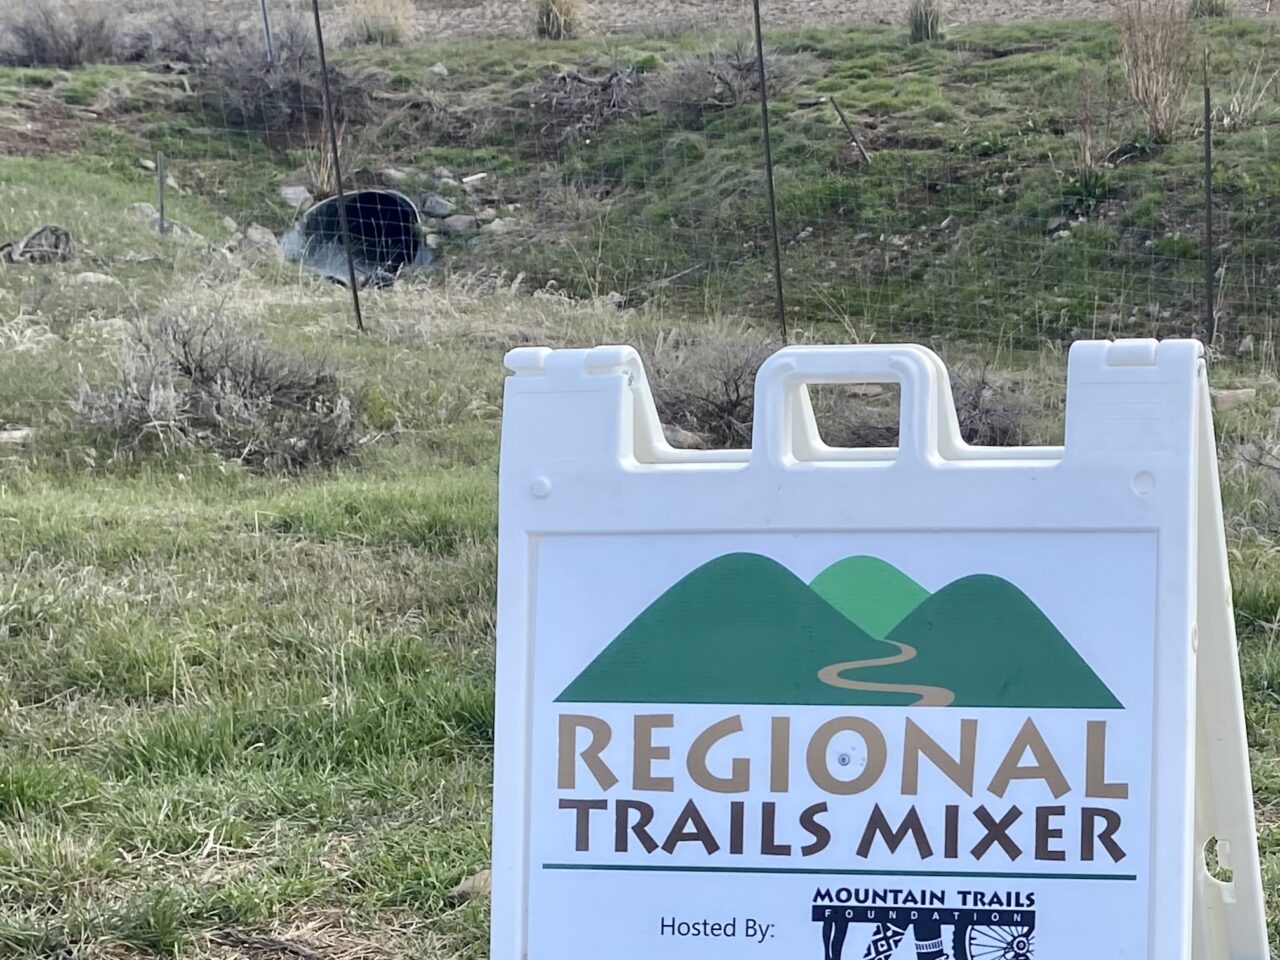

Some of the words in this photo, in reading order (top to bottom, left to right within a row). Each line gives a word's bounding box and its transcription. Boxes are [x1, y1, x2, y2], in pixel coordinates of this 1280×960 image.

[557, 713, 1129, 799] REGIONAL
[559, 798, 830, 857] TRAILS
[856, 804, 1126, 863] MIXER
[813, 887, 945, 906] MOUNTAIN
[958, 891, 1035, 908] TRAILS
[823, 908, 1022, 922] FOUNDATION
[660, 918, 736, 938] Hosted
[745, 919, 775, 943] By:
